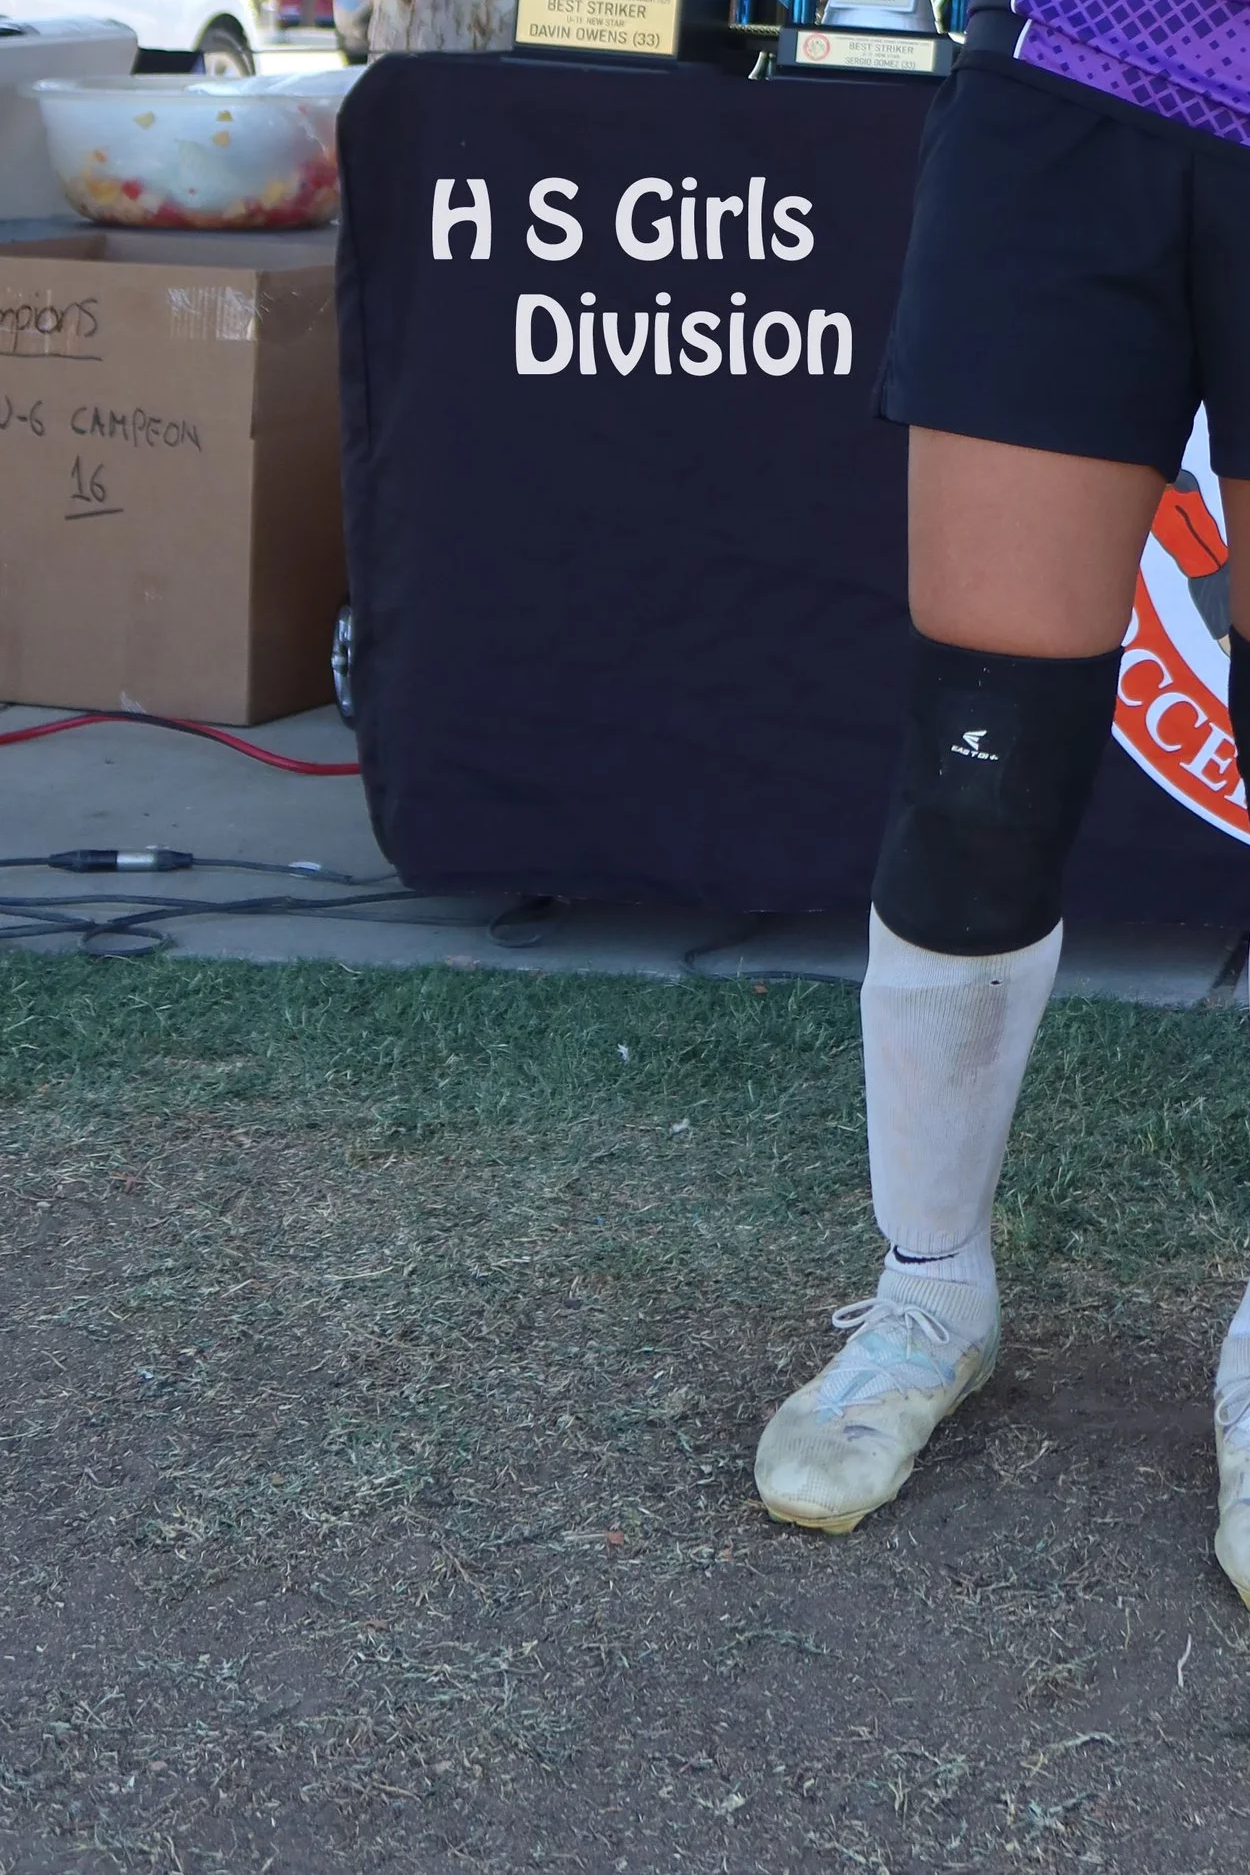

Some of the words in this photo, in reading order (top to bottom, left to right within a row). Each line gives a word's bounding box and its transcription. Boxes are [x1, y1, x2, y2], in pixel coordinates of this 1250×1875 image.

[587, 0, 646, 18] STRIKER
[529, 23, 571, 39] DAVIN
[576, 27, 627, 44] OWENS
[632, 32, 660, 48] (33)
[70, 407, 202, 452] CAMPEON
[71, 454, 107, 503] 16
